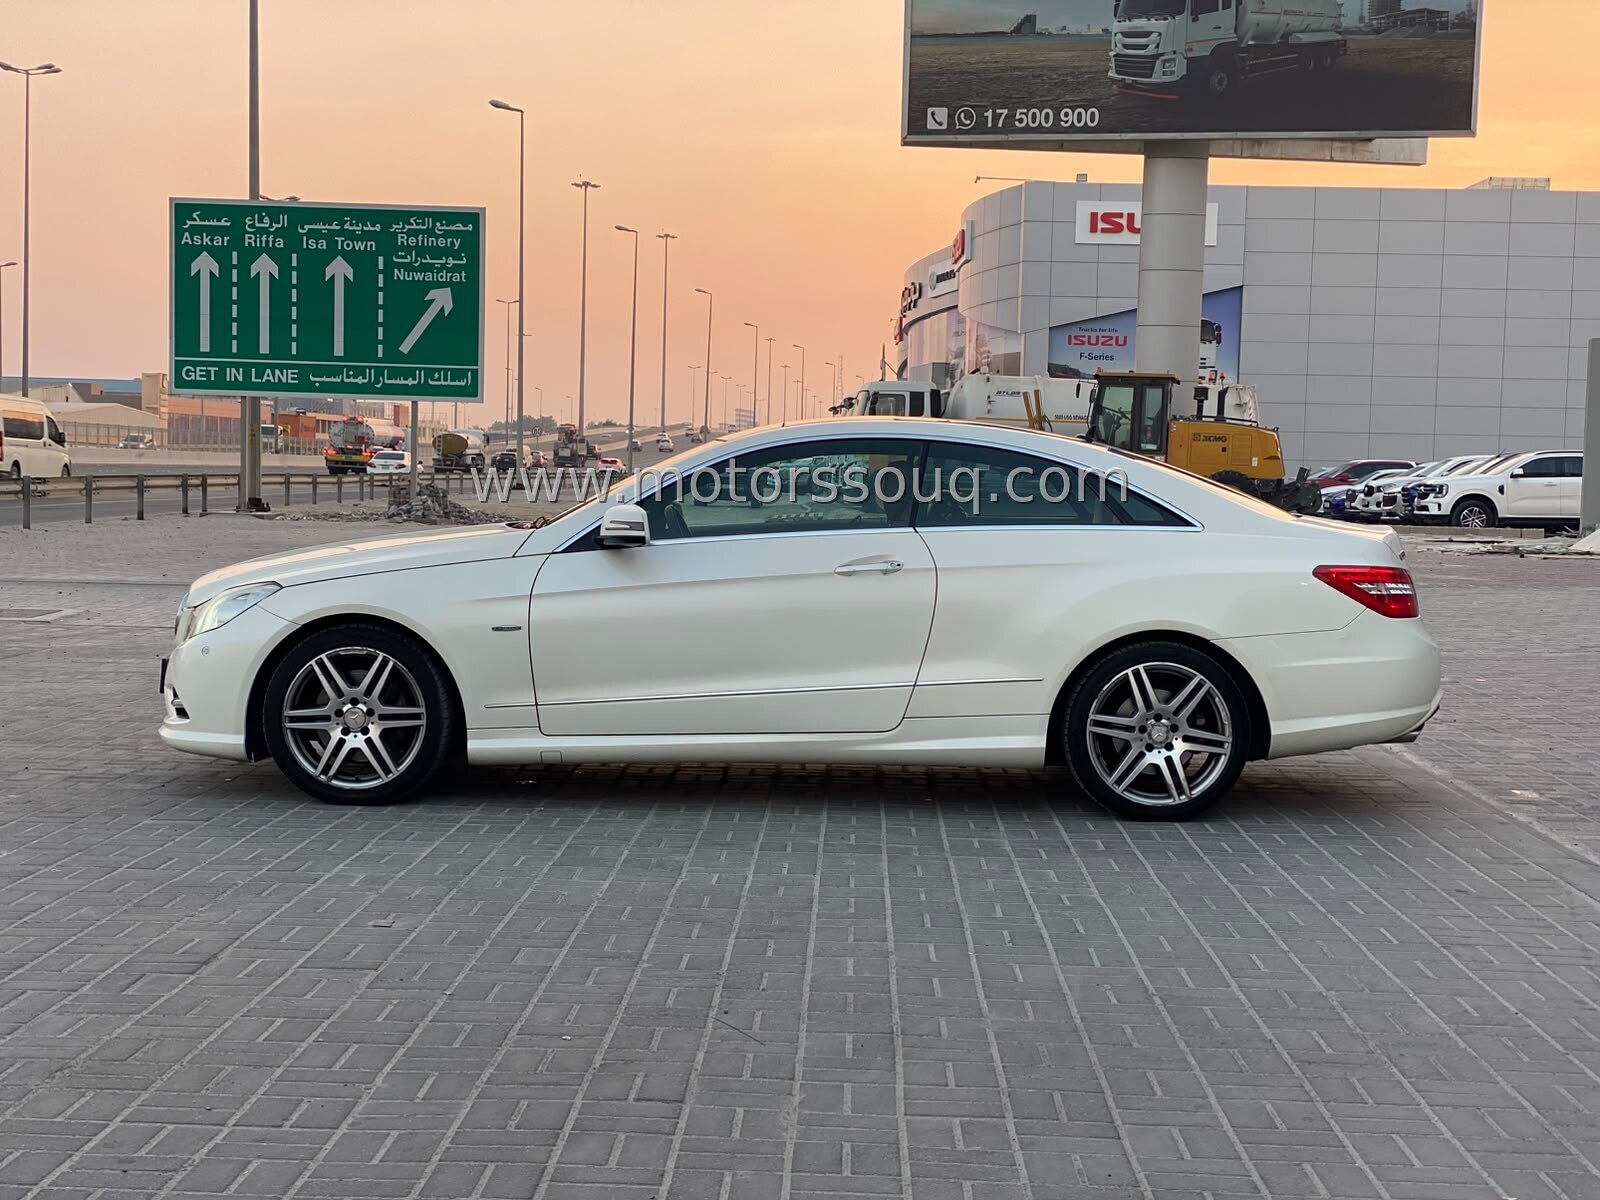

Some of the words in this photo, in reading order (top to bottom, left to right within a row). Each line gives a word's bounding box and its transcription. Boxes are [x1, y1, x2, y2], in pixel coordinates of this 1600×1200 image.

[983, 108, 1008, 128] 17
[1014, 108, 1053, 128] 500
[1060, 107, 1099, 127] 900
[181, 211, 231, 228] عسكر
[244, 212, 288, 231] الرفاع
[297, 220, 341, 233] عيسى
[344, 216, 381, 234] مدينة
[388, 216, 432, 232] التكرير
[434, 220, 473, 234] مصنع
[181, 232, 230, 246] Askar
[244, 233, 284, 248] Riffa
[303, 236, 327, 249] Isa
[334, 236, 376, 251] Town
[397, 233, 461, 249] Refinery
[392, 250, 467, 267] نويدرات
[393, 268, 466, 282] Nuwaidrat
[1067, 335, 1128, 347] ISUZU
[1080, 353, 1114, 361] F-Series
[182, 366, 218, 381] GET
[226, 367, 243, 382] IN
[251, 368, 299, 383] LANE
[309, 367, 375, 387] المناسب
[374, 369, 424, 388] المسار
[428, 370, 472, 386] اسلك
